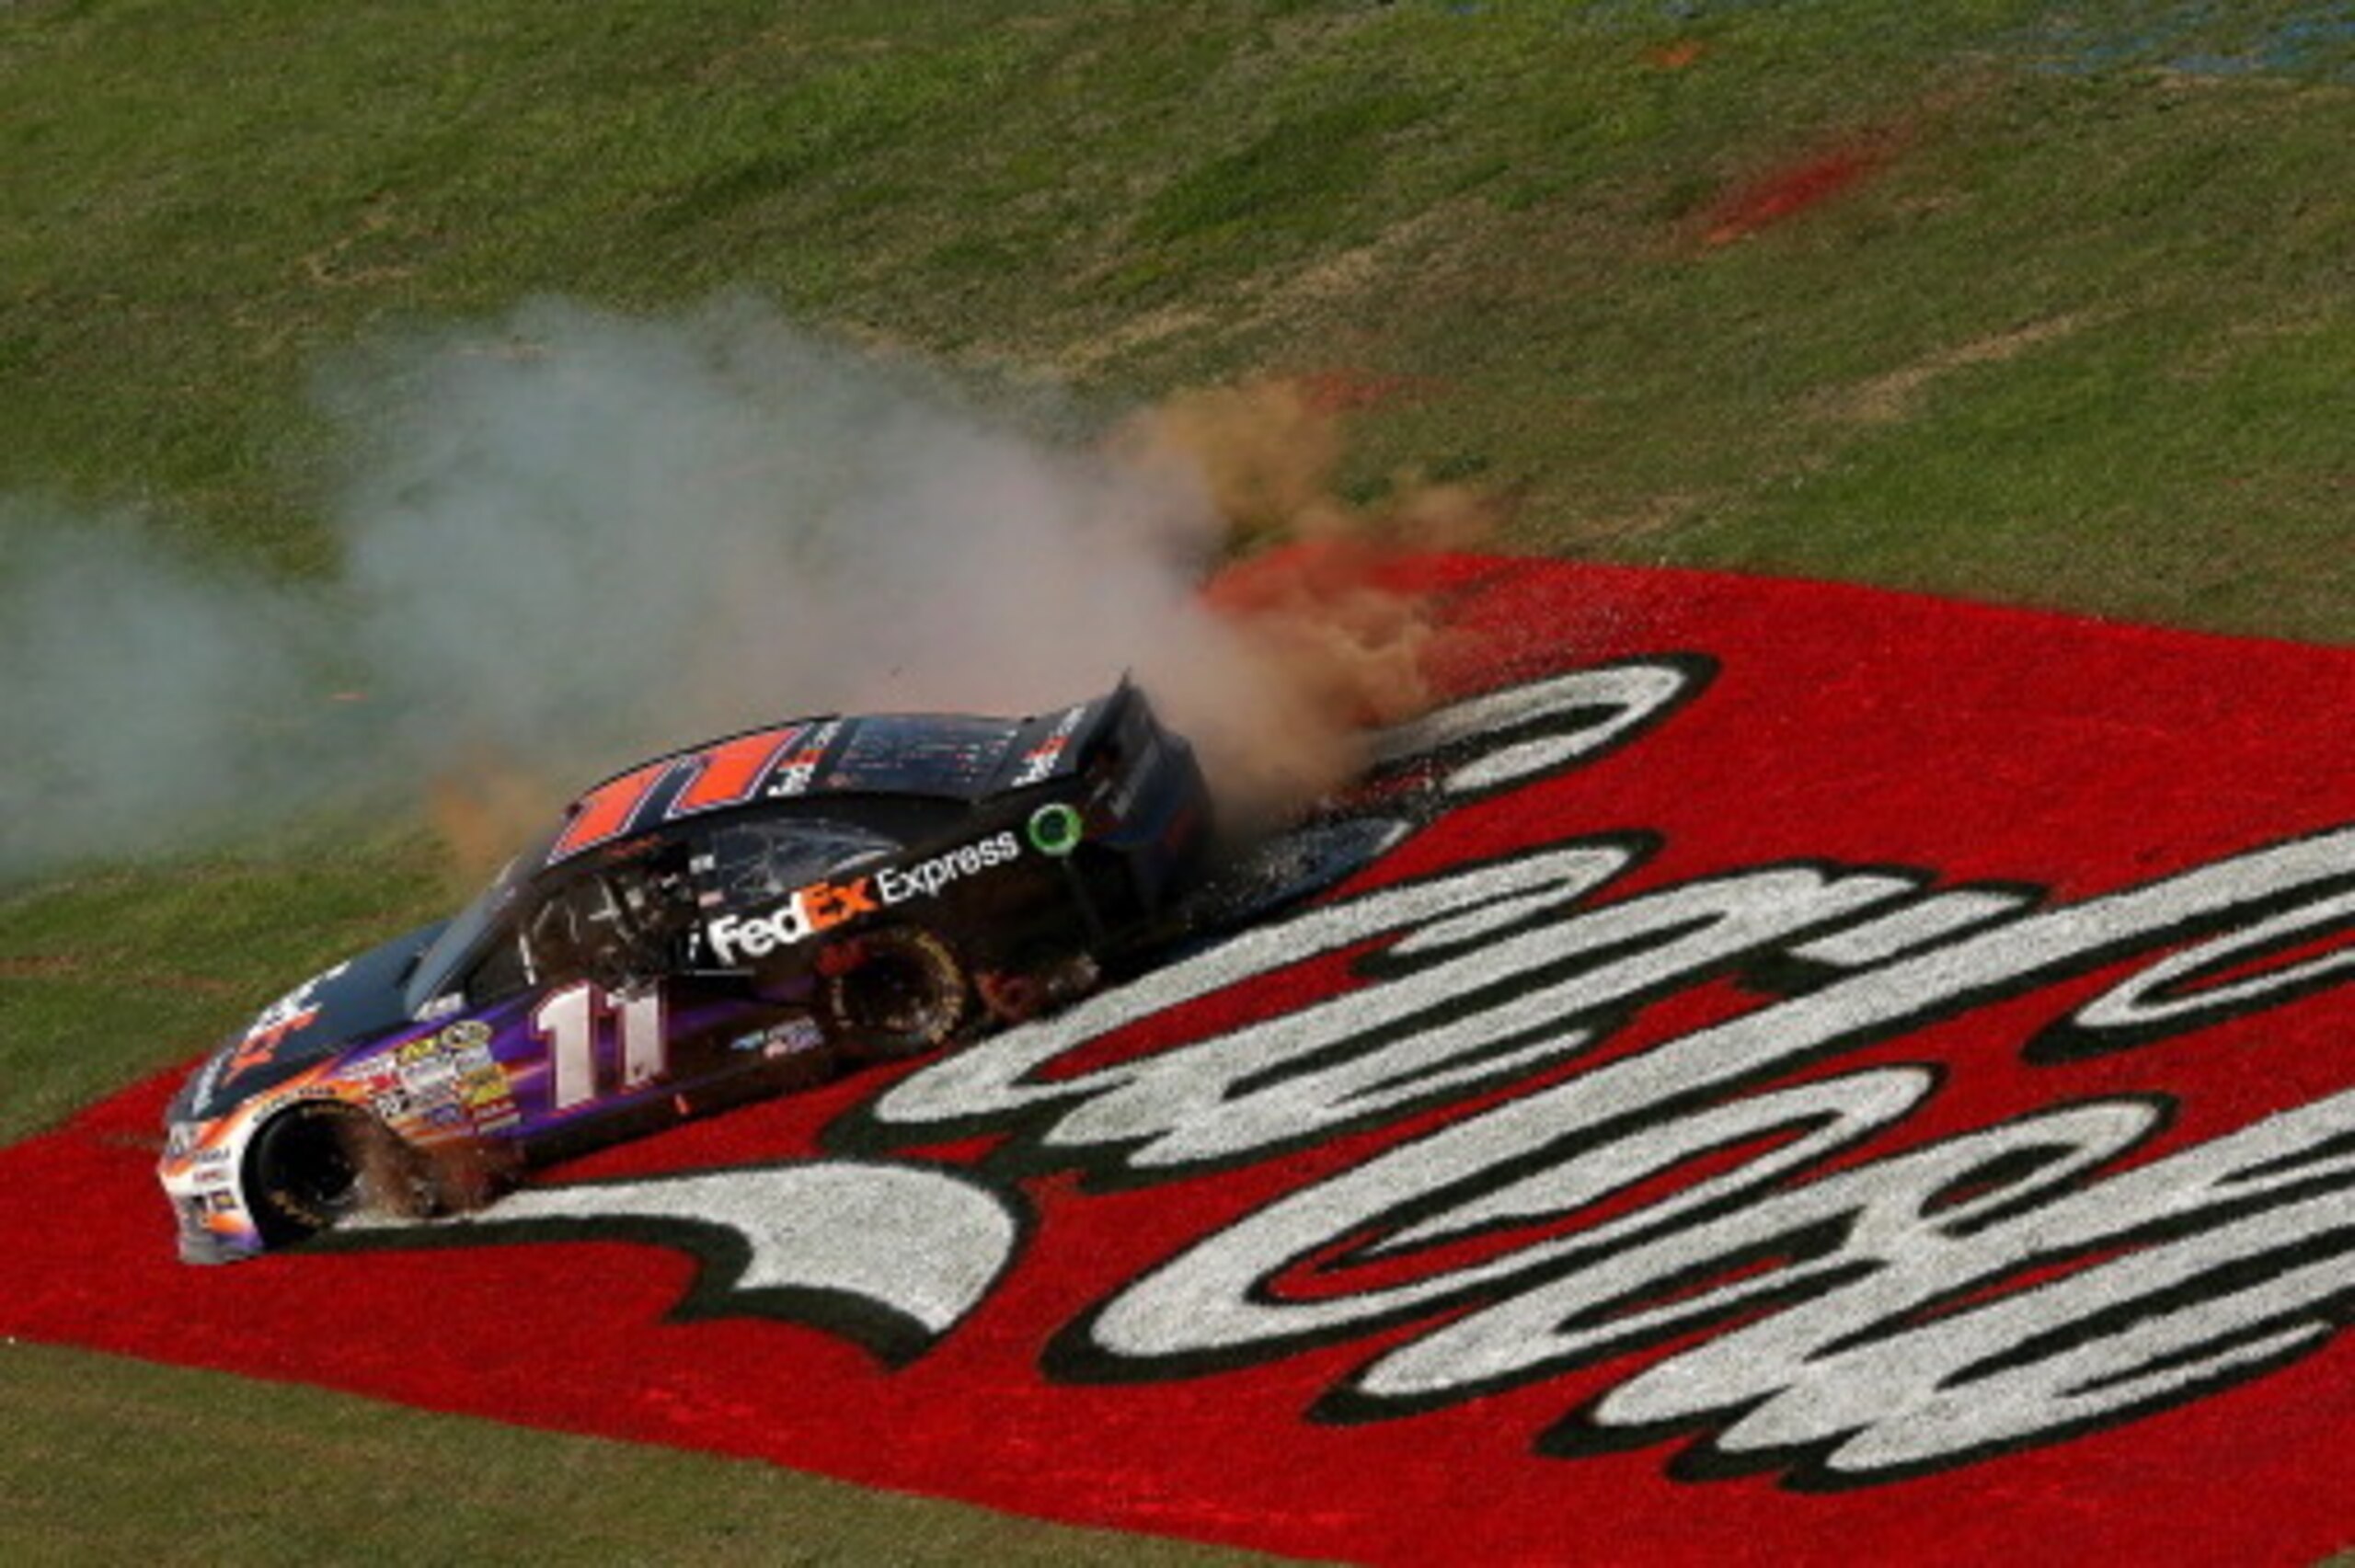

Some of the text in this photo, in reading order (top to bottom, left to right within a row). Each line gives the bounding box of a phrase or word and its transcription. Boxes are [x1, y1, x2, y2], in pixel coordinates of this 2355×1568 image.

[548, 725, 813, 864] 11
[707, 831, 1021, 967] FedEx Express
[317, 658, 2355, 1473] ca-Cola
[532, 980, 668, 1110] 11
